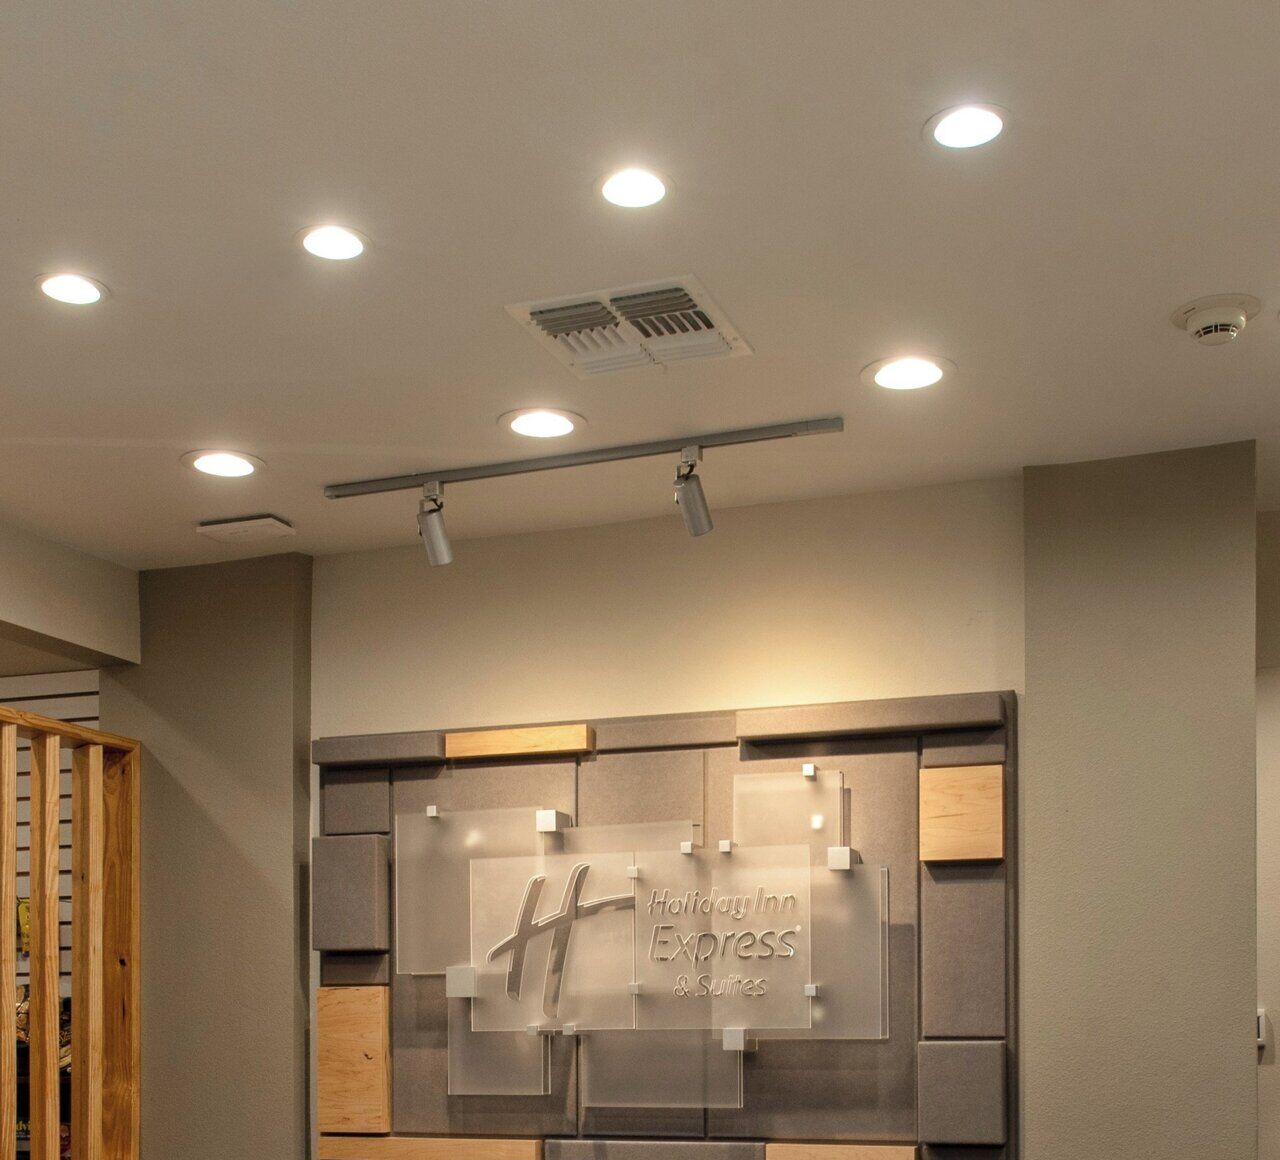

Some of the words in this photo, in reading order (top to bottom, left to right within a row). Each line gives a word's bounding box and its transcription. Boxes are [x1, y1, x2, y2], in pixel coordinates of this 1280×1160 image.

[647, 887, 751, 920] Holiday
[754, 885, 796, 913] Inn
[648, 924, 796, 969] Express
[673, 975, 689, 998] &
[695, 974, 767, 997] Suites
